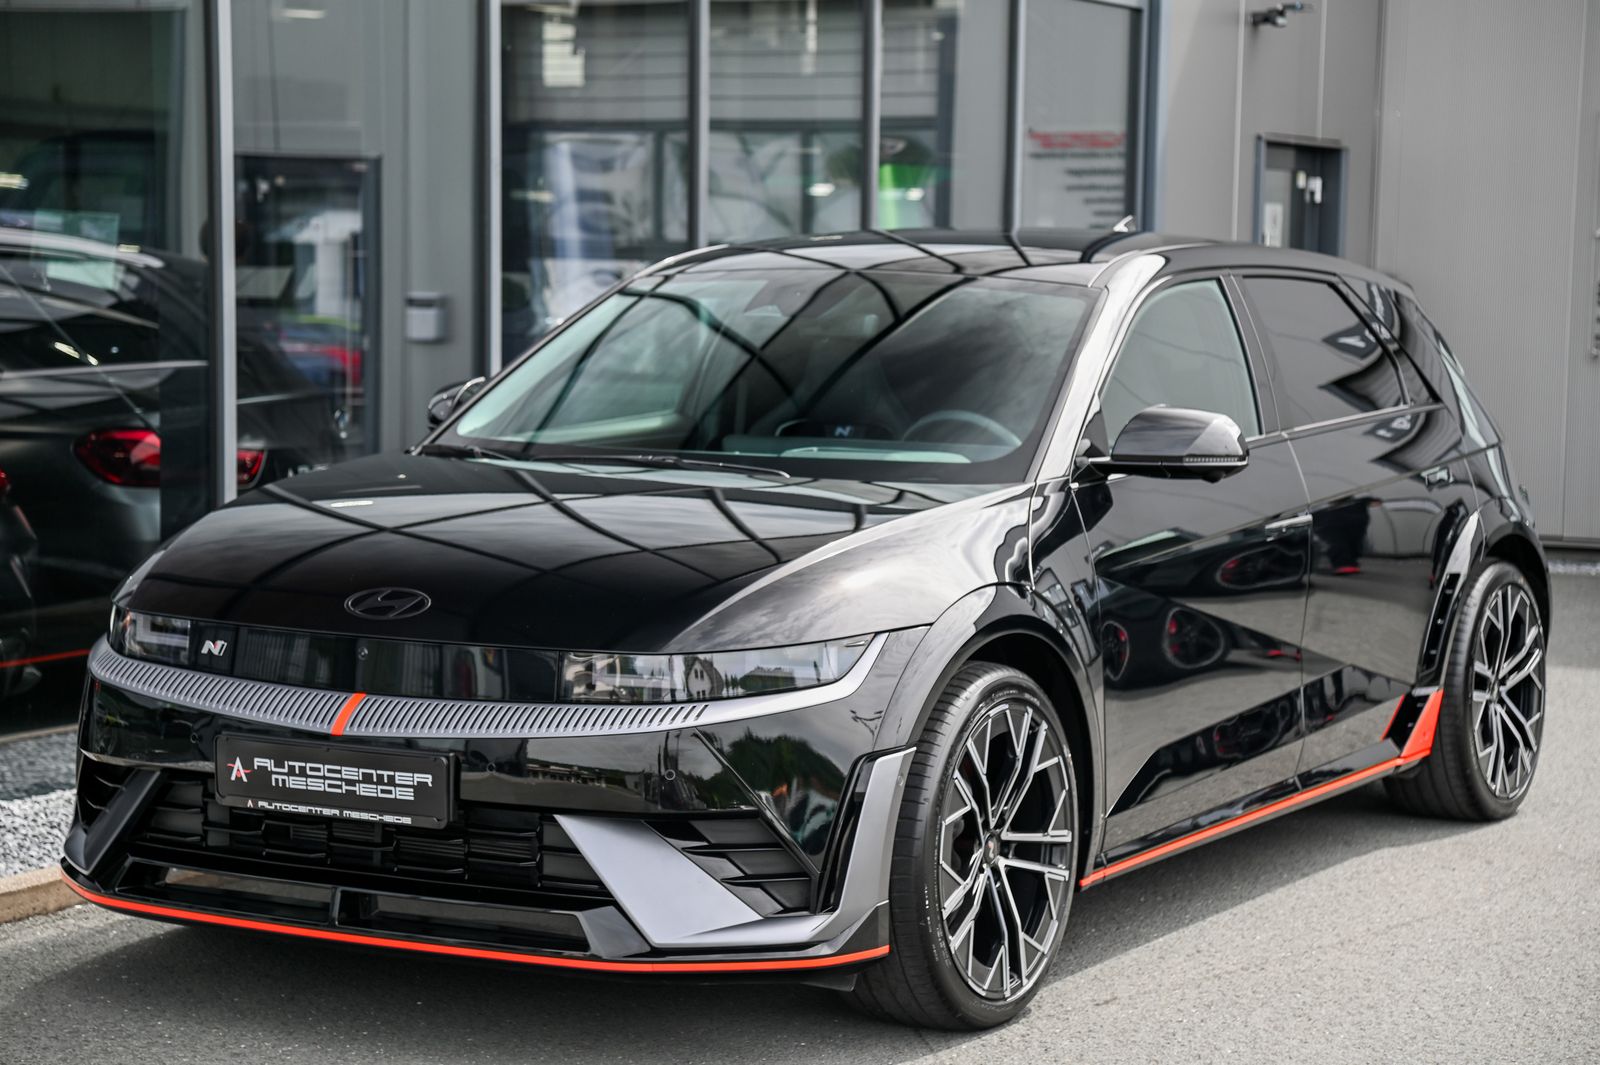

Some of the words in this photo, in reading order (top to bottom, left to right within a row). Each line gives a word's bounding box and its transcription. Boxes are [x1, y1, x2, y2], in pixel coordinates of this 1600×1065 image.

[253, 757, 433, 787] AUTOCENTER
[271, 773, 415, 801] MESCHEDE
[257, 800, 340, 817] AUTOCENTER
[342, 809, 412, 825] MESCHEDE
